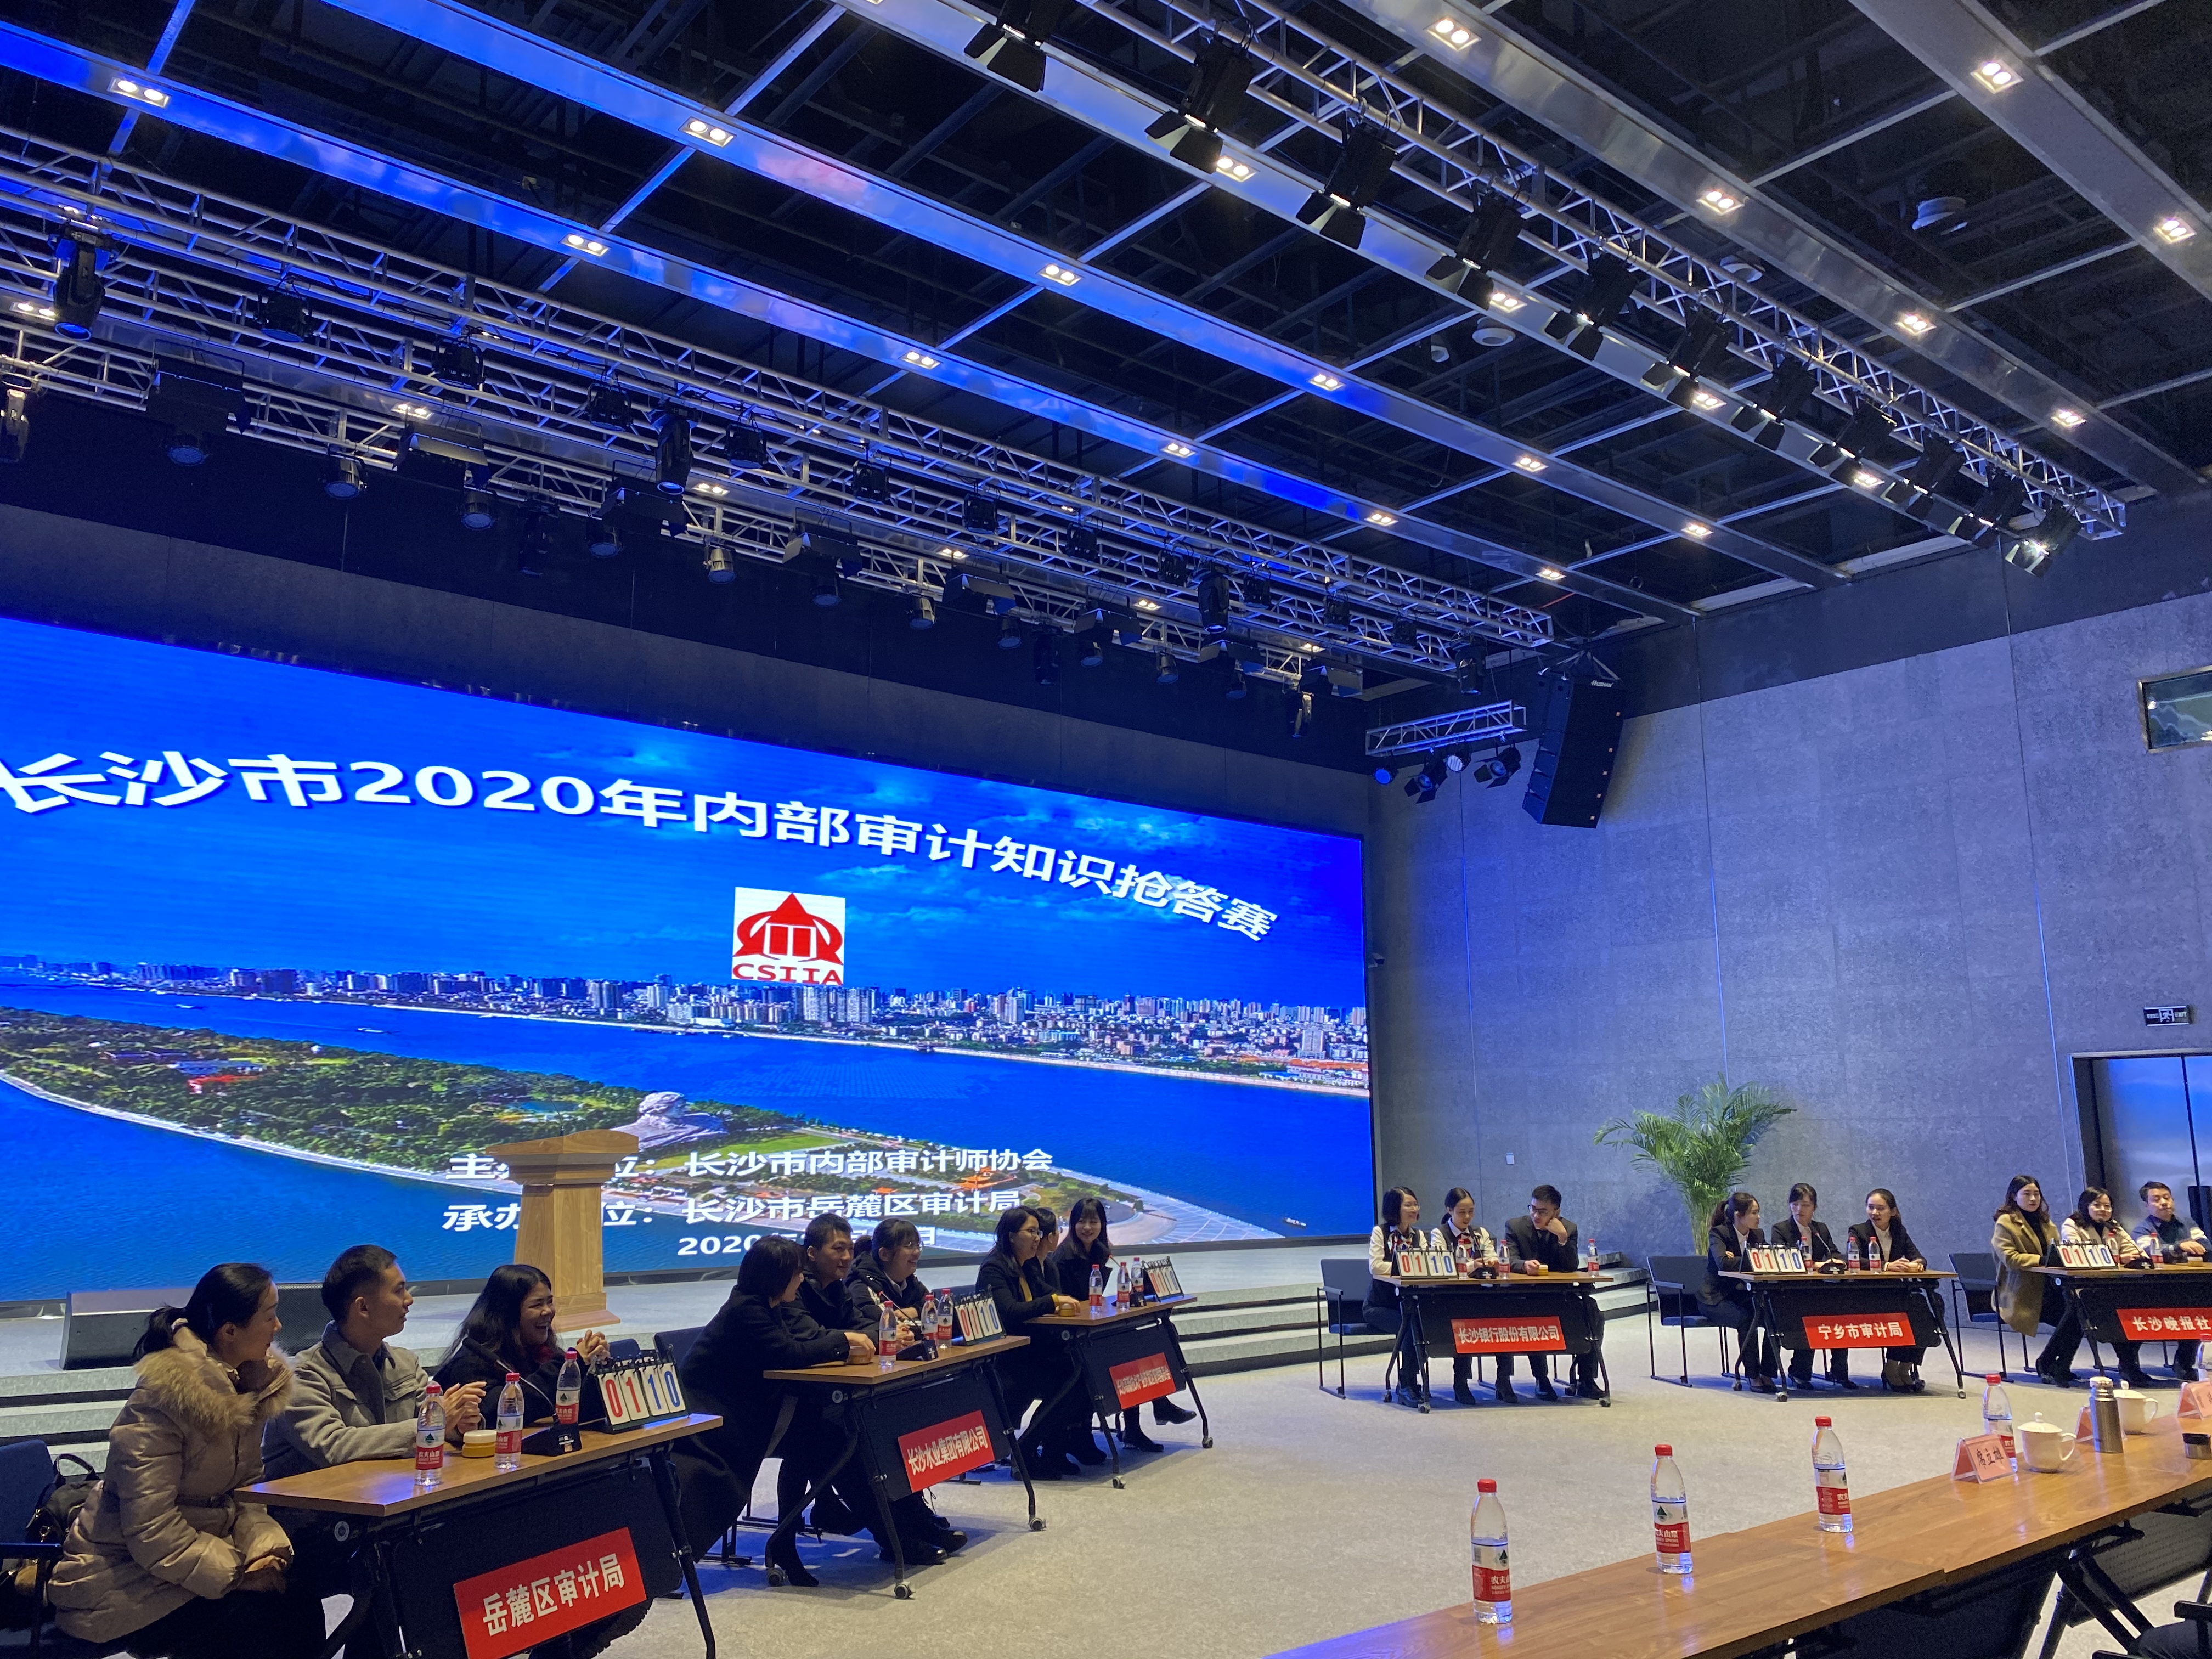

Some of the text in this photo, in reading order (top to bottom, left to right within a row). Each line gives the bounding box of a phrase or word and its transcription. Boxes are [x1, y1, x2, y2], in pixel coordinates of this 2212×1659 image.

[0, 751, 1278, 941] 长沙市2020年内部审计知识抢答赛
[732, 963, 843, 986] CSIIA
[685, 1149, 1053, 1177] 长沙市内部审计师协会
[682, 1190, 1020, 1224] 长沙市岳麓区审计局
[1458, 1325, 1560, 1344] 长沙银行股份有限公司
[1818, 1322, 1903, 1340] 宁乡市审计局
[2132, 1315, 2212, 1331] 长沙晚报社
[907, 1425, 988, 1476] 长沙水业集团有限公司
[483, 1553, 625, 1637] 岳麓区审计局
